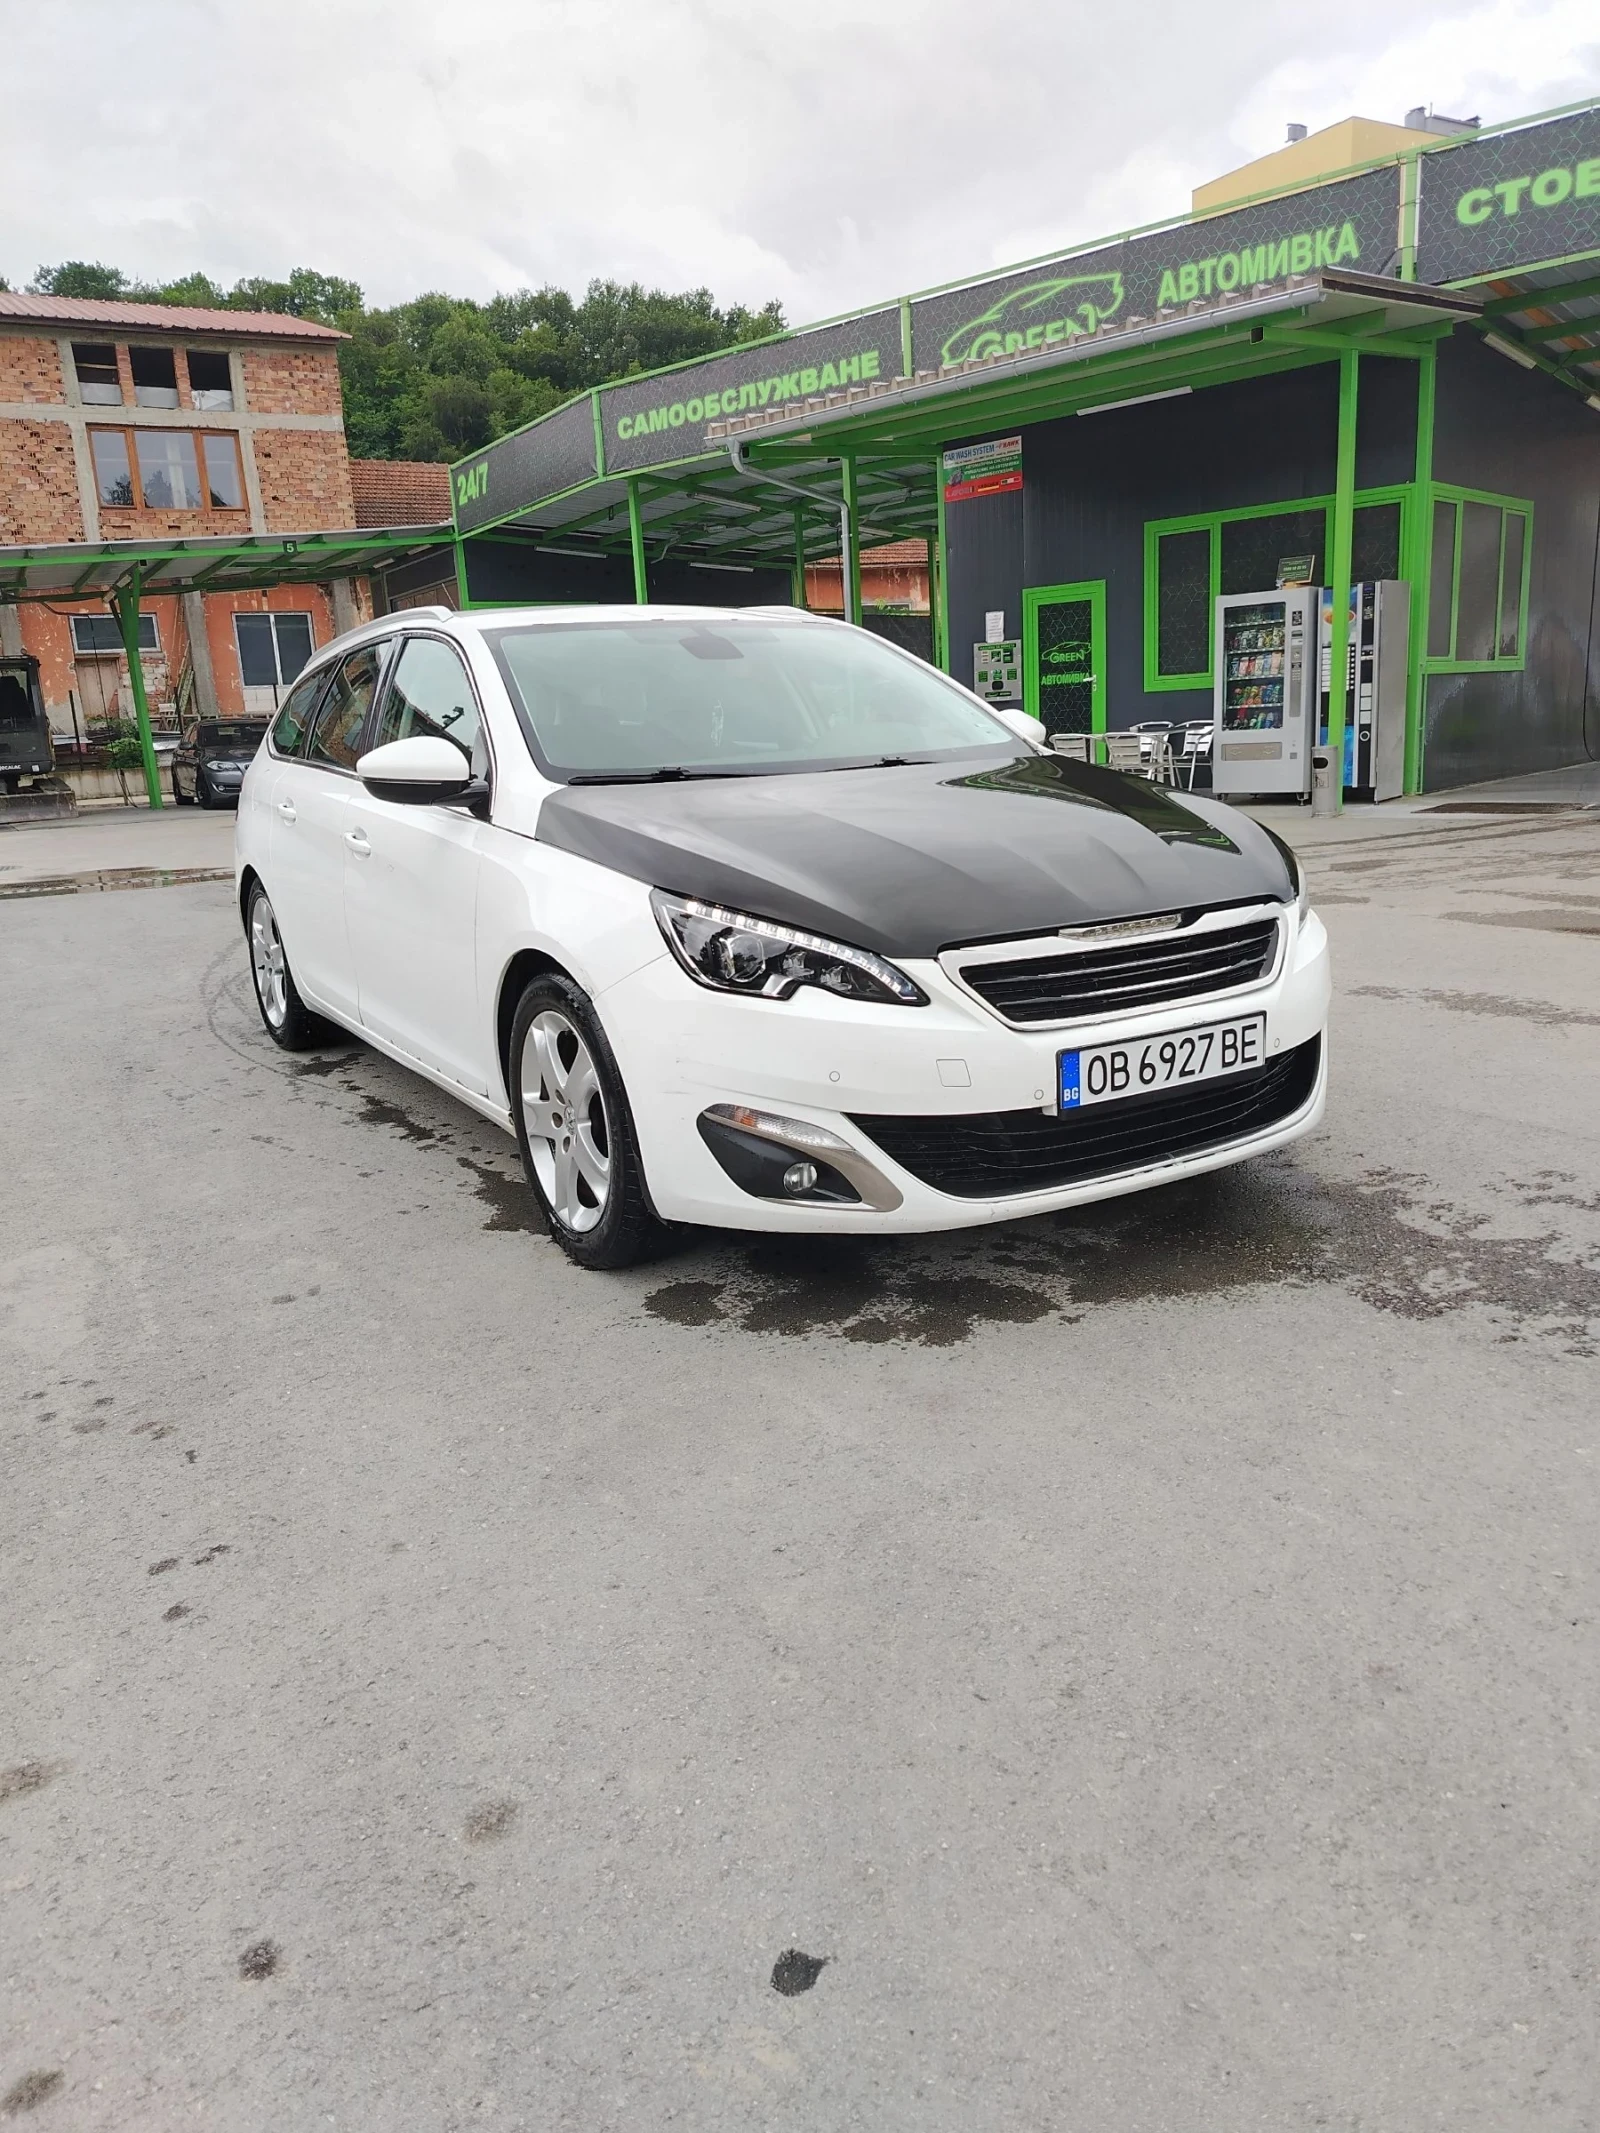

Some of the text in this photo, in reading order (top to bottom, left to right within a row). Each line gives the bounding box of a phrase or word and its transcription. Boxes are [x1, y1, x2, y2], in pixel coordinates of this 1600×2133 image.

[1156, 222, 1361, 307] АВТОМИВКА
[616, 350, 881, 441] САМООБСЛУЖВАНЕ
[944, 452, 955, 462] CAR
[955, 449, 973, 460] WASH
[973, 444, 995, 456] SYSTEM
[456, 462, 490, 506] 24/7
[286, 543, 295, 553] 5
[1049, 649, 1085, 664] GREEN
[1087, 1023, 1258, 1096] OB 6927 BE
[1063, 1087, 1080, 1102] BG
